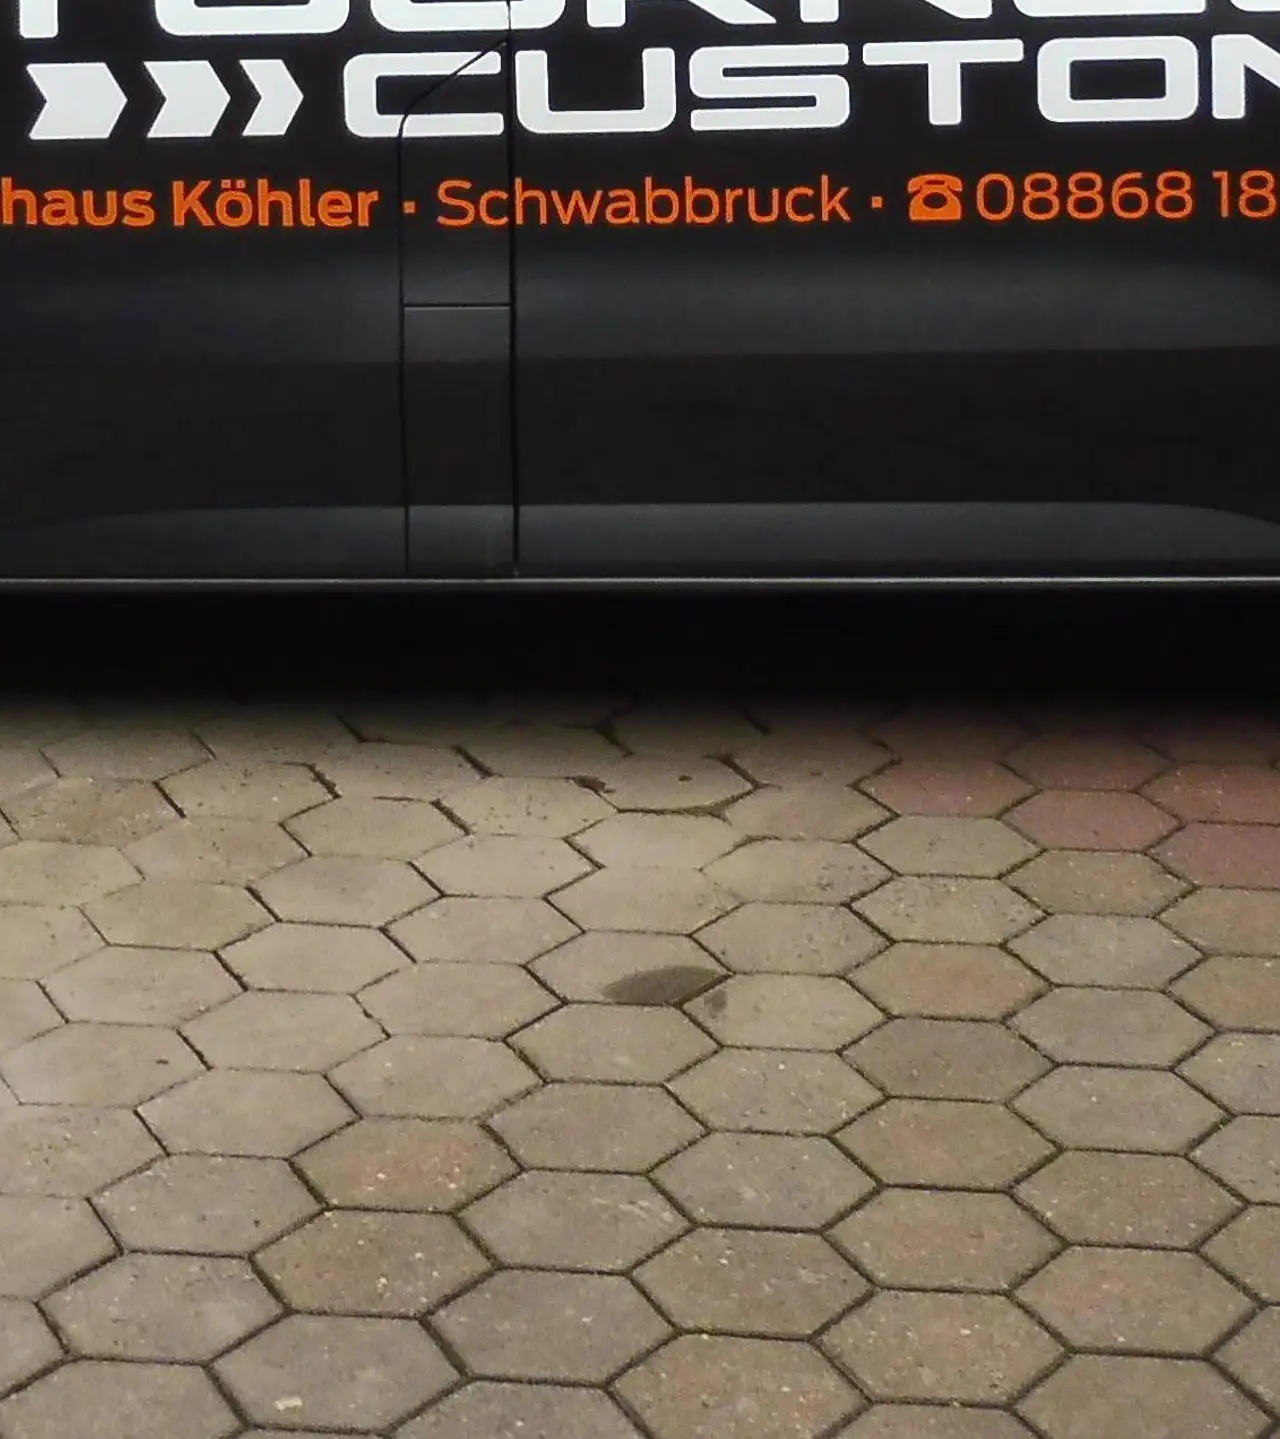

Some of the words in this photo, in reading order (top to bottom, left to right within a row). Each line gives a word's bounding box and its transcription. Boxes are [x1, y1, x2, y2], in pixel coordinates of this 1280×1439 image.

[171, 177, 380, 229] Köhler
[436, 175, 852, 229] Schwabbruck
[974, 169, 1196, 223] 08868
